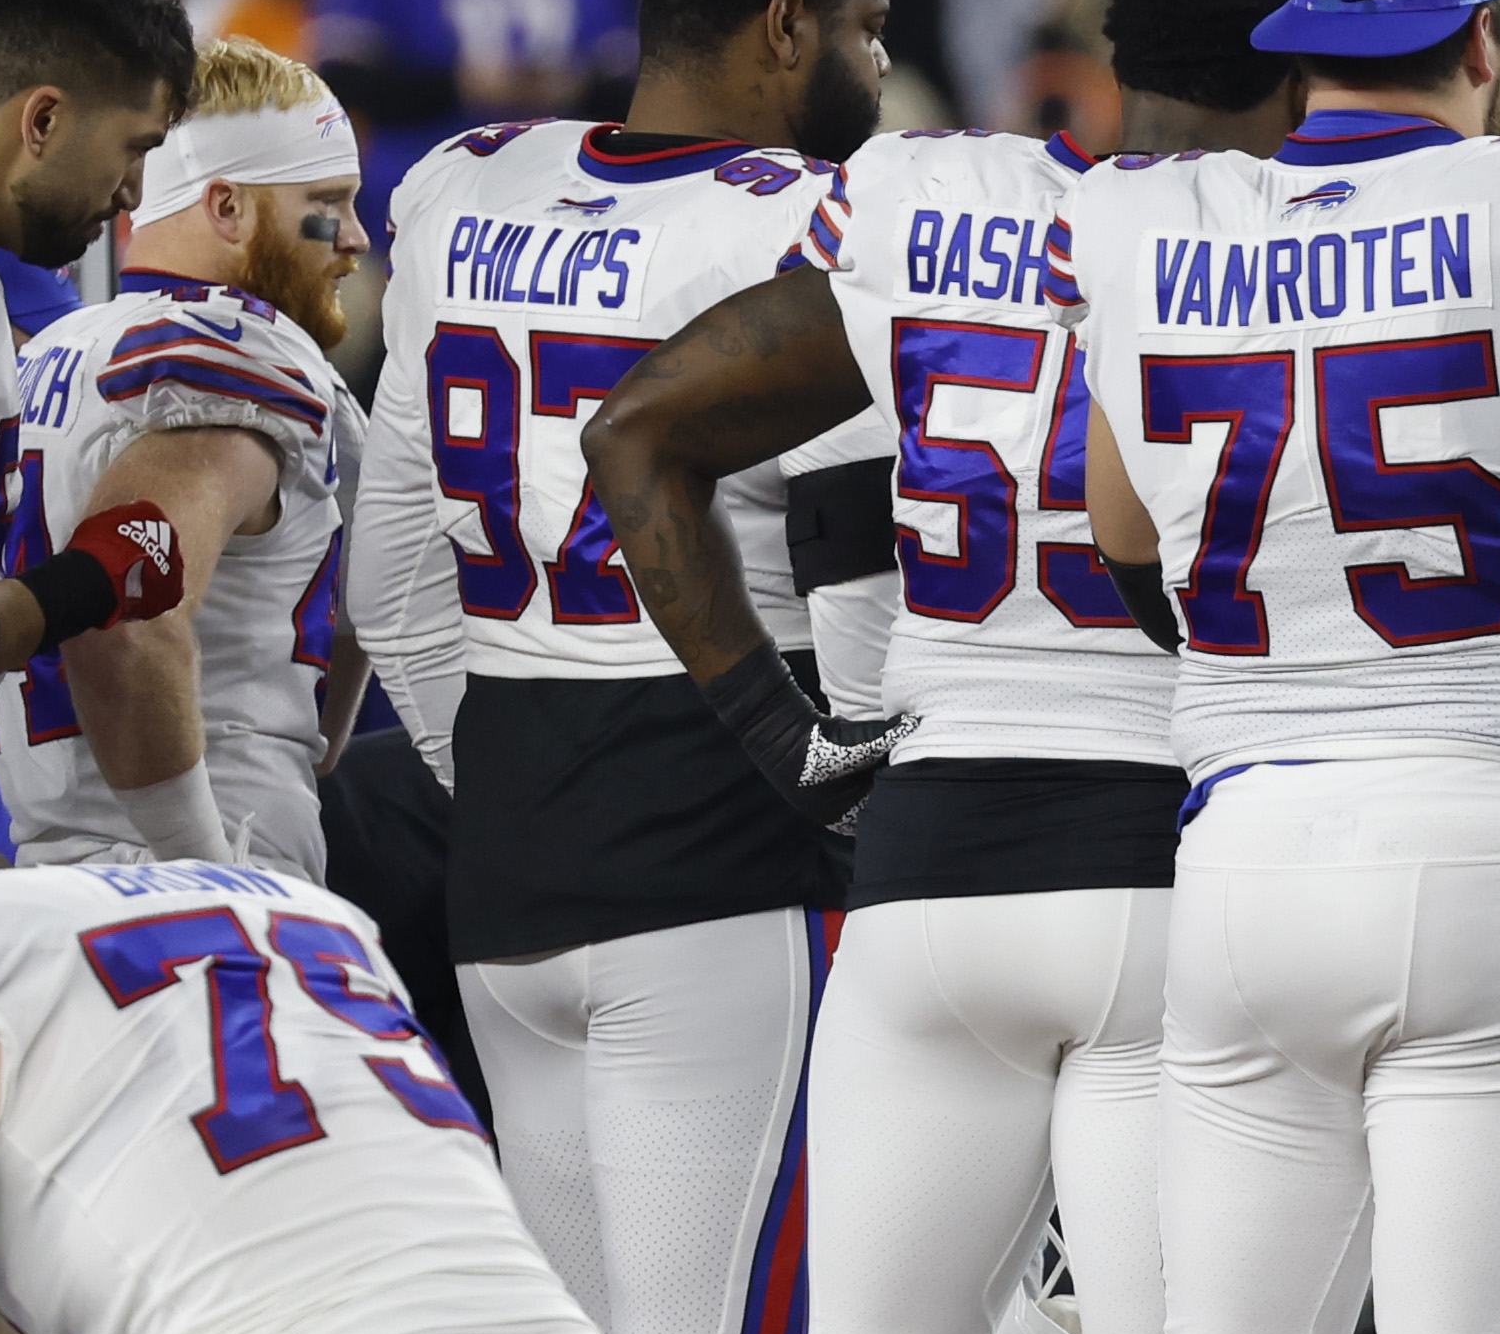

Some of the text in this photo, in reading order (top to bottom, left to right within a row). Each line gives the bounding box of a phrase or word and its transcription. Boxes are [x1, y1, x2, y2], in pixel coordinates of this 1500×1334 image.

[447, 216, 641, 309] PHILLIPS
[1155, 212, 1473, 328] VANROTEN
[425, 320, 670, 625] 97
[116, 522, 171, 576] adidas
